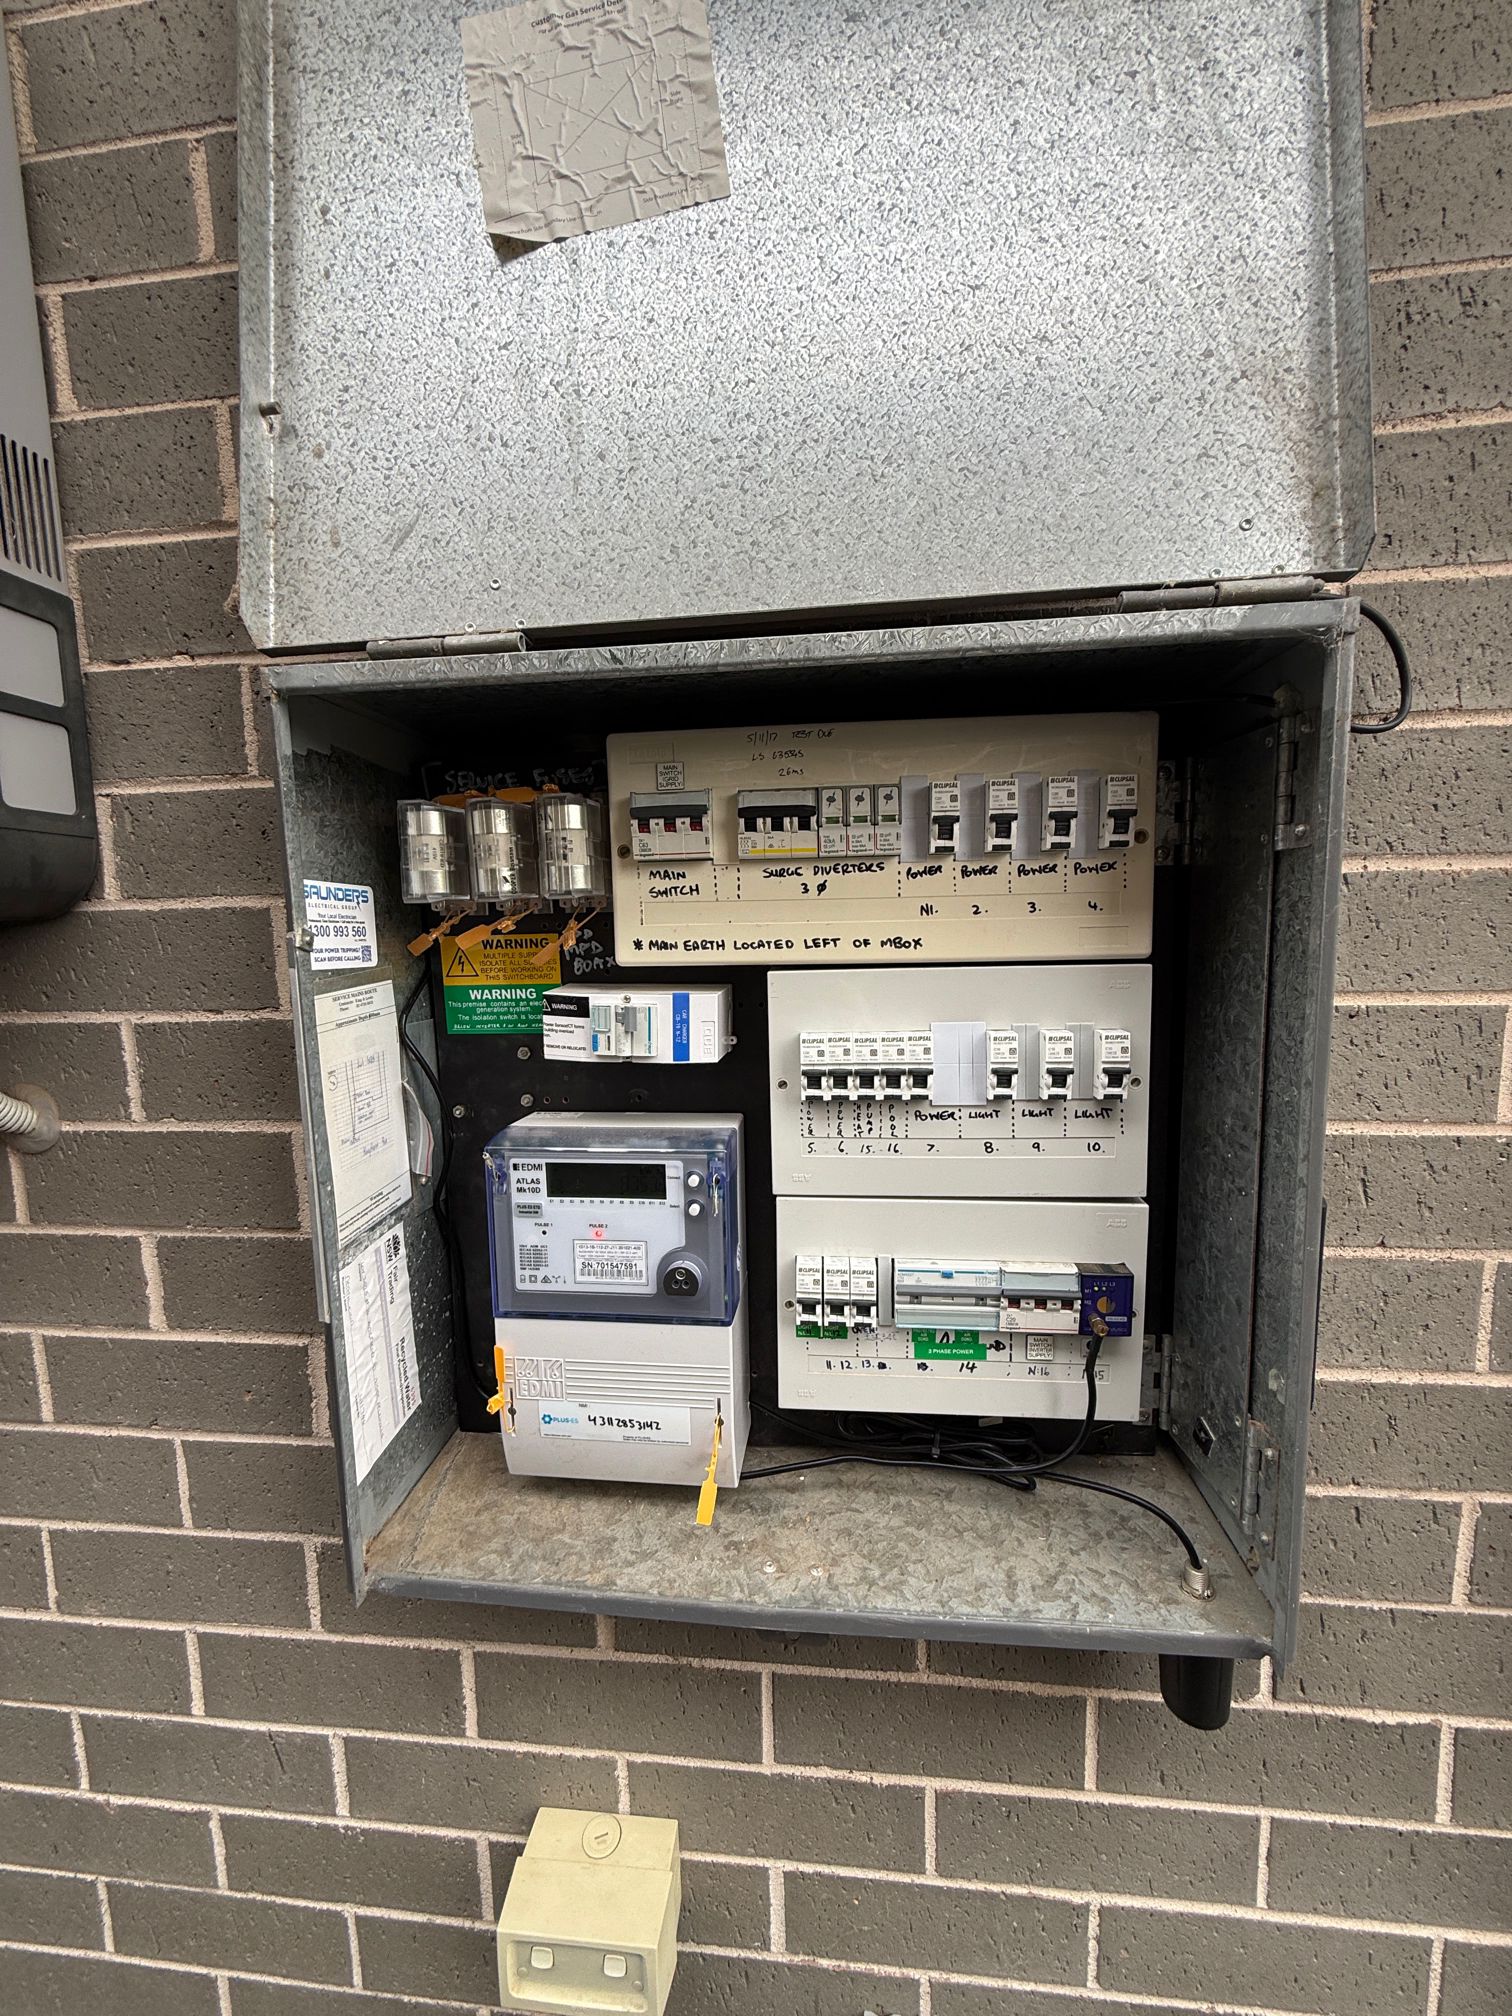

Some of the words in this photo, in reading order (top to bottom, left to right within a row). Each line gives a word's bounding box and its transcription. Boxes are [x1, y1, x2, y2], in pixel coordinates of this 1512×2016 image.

[580, 2, 605, 15] Service
[996, 779, 1016, 787] CLIPSAL
[762, 867, 803, 878] SURGE
[813, 862, 885, 876] DIVERTERS
[906, 864, 943, 880] POWER
[960, 864, 998, 879] POWER
[1017, 863, 1058, 877] POWER
[1073, 860, 1118, 875] POWER
[649, 869, 686, 881] MAIN
[303, 884, 369, 904] SAUNDERS
[649, 884, 700, 898] SWITCH
[801, 883, 809, 894] 3
[308, 902, 340, 910] ELECTRICAL
[308, 924, 331, 938] 1300
[333, 925, 350, 938] 993
[351, 925, 367, 938] 560
[481, 937, 550, 950] WARNING
[649, 940, 678, 951] MAIN
[684, 940, 725, 951] EARTH
[733, 939, 795, 950] LOCATED
[803, 938, 841, 949] LEFT
[852, 938, 871, 948] OF
[483, 952, 518, 960] MULTIPLE
[479, 959, 507, 967] ISOLATE
[502, 973, 554, 981] SWITCHBOARD
[469, 988, 537, 1000] WARNING
[551, 1003, 578, 1011] WARNING
[914, 1109, 958, 1121] POWER
[968, 1110, 1001, 1119] LIGHT
[1021, 1108, 1055, 1118] LIGHT
[1074, 1108, 1114, 1120] LIGHT
[888, 1103, 899, 1137] POOL
[521, 1162, 543, 1171] EDMI
[516, 1177, 541, 1185] ATLAS
[516, 1186, 541, 1194] Mk10D
[386, 1238, 394, 1263] NSW
[581, 1261, 638, 1270] SN:701547591
[392, 1265, 400, 1283] Fair
[387, 1270, 397, 1305] Trading
[399, 1337, 411, 1381] Recycled
[959, 1361, 978, 1373] 14
[519, 1380, 561, 1398] EDMI
[403, 1381, 413, 1412] Water
